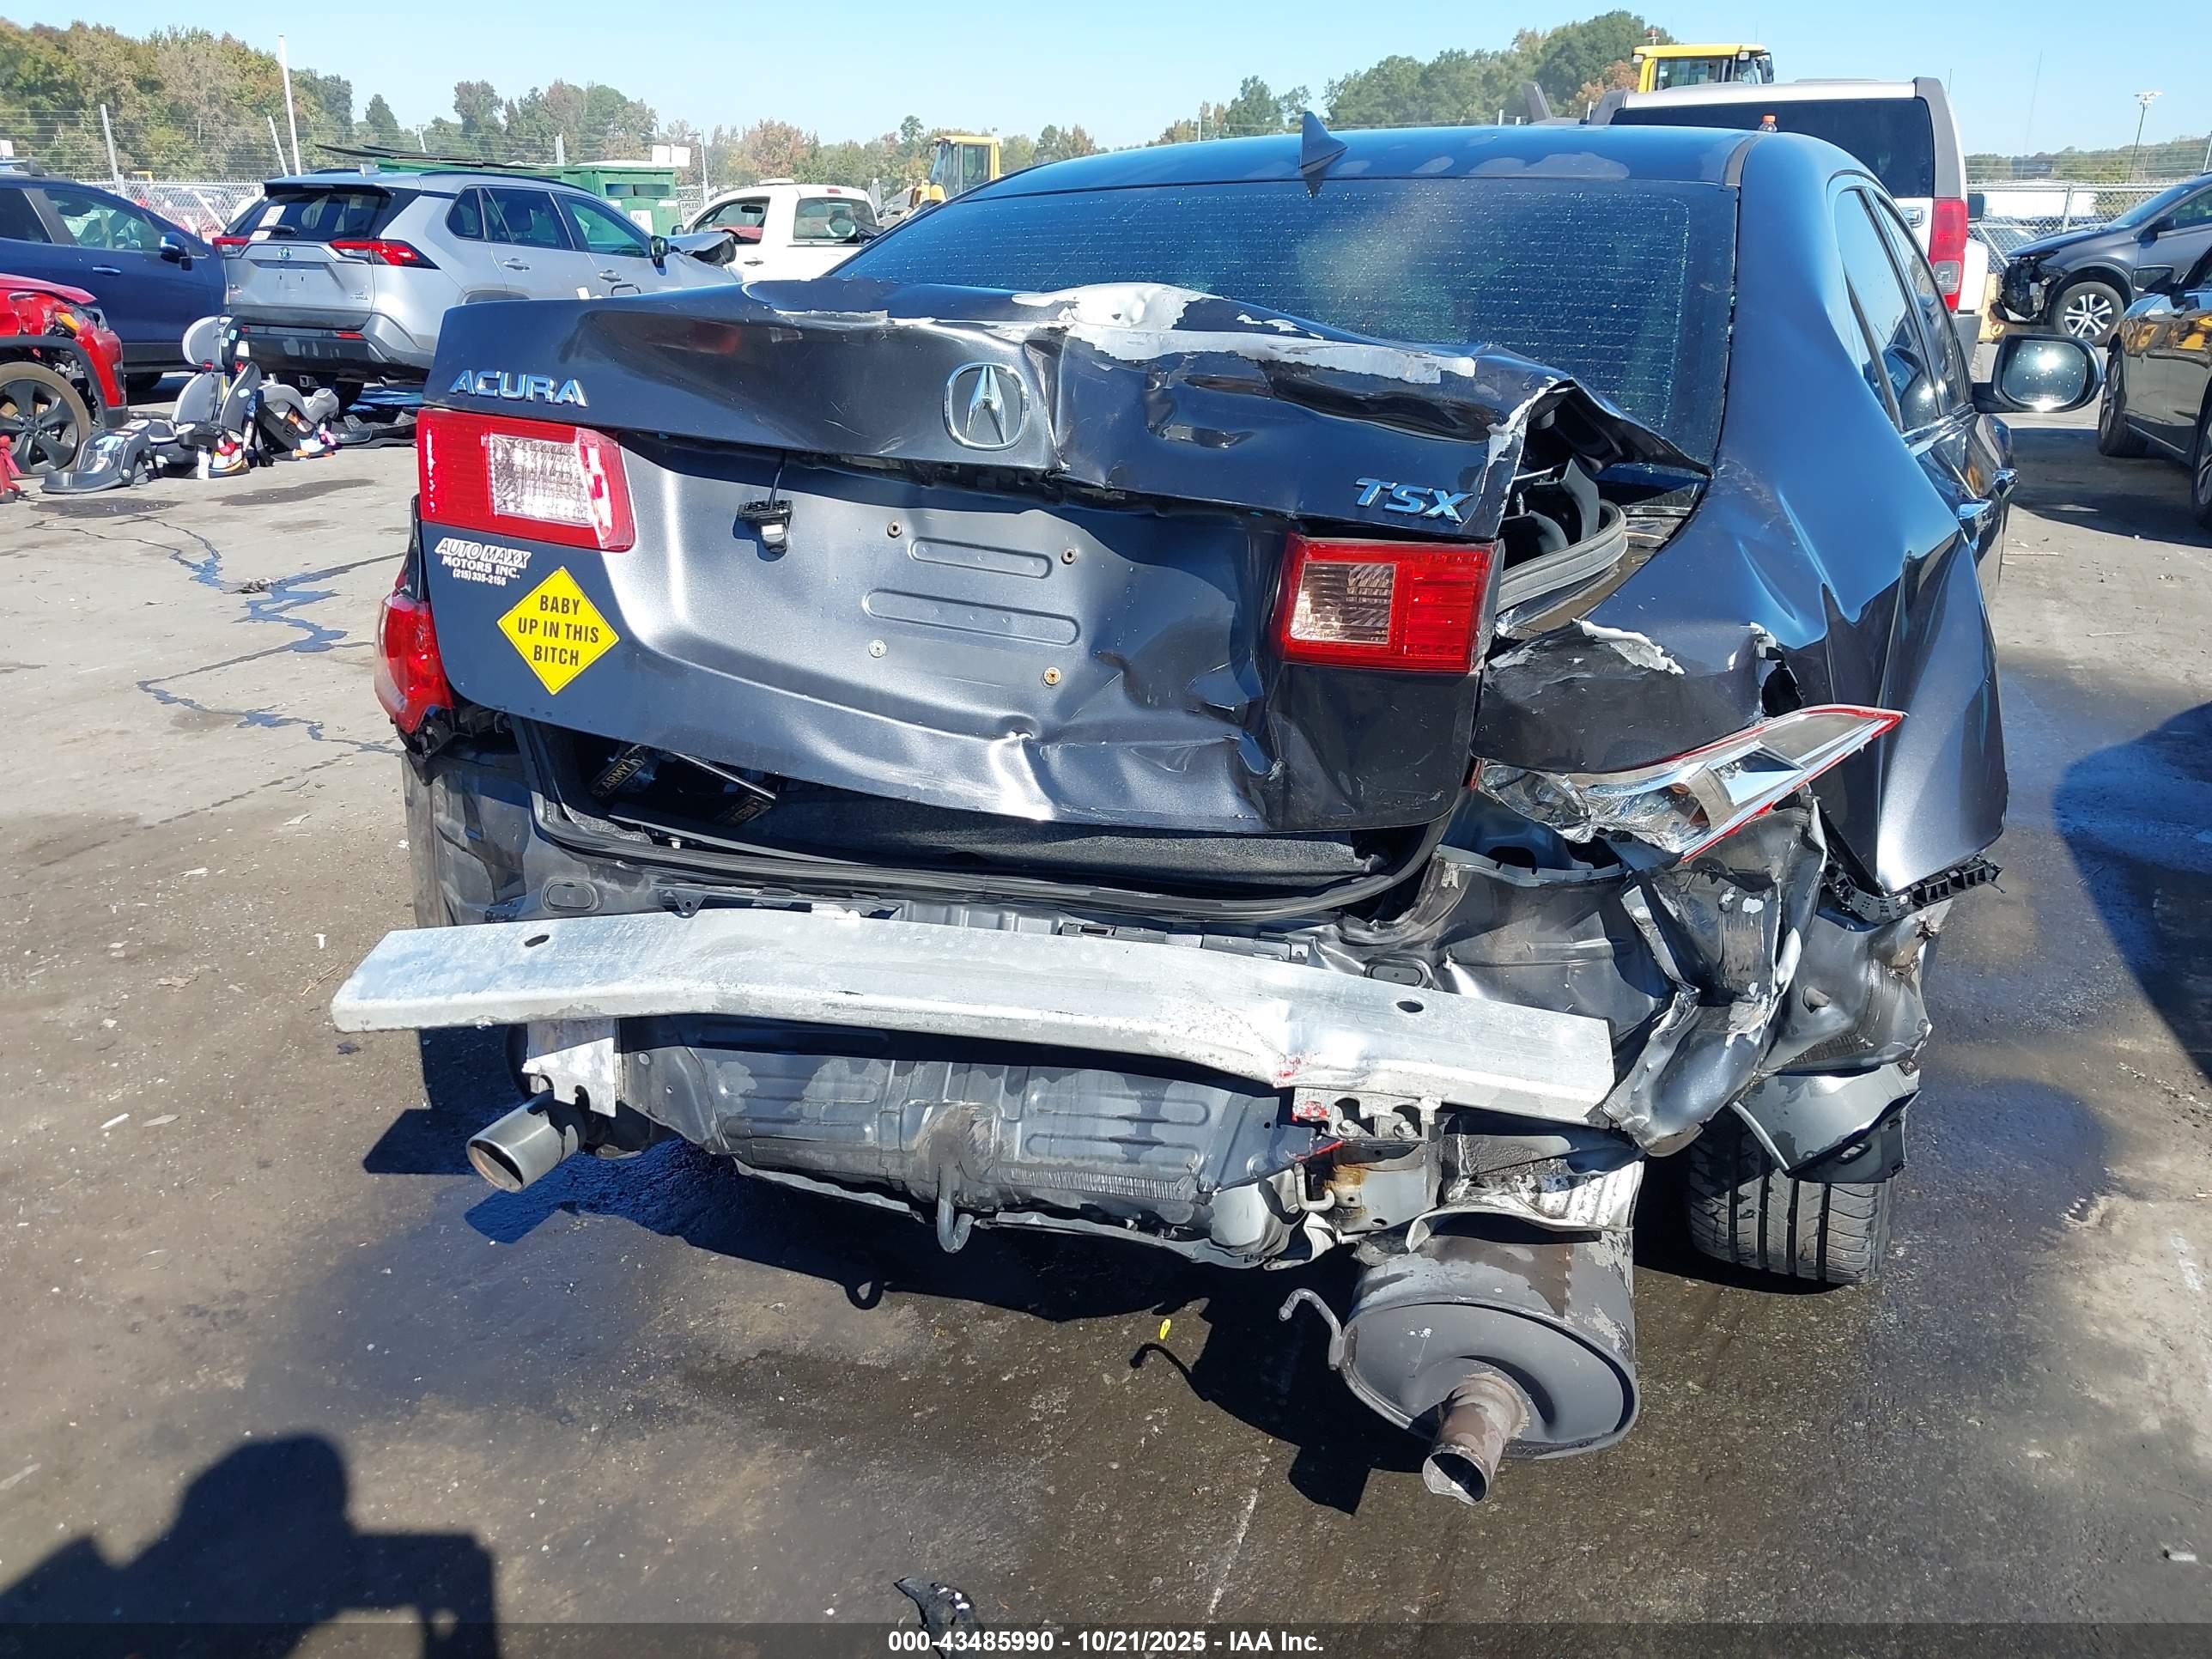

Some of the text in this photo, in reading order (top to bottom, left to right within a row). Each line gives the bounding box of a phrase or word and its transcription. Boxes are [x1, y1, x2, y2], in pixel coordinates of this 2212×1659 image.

[448, 369, 589, 408] ACURA
[1354, 477, 1474, 524] TSX
[441, 555, 520, 579] MOTORS INC.
[453, 568, 471, 580] (215)
[540, 594, 580, 616] BABY
[518, 617, 599, 643] UP IN THIS
[533, 645, 579, 666] BITCH
[602, 763, 632, 789] ARMY
